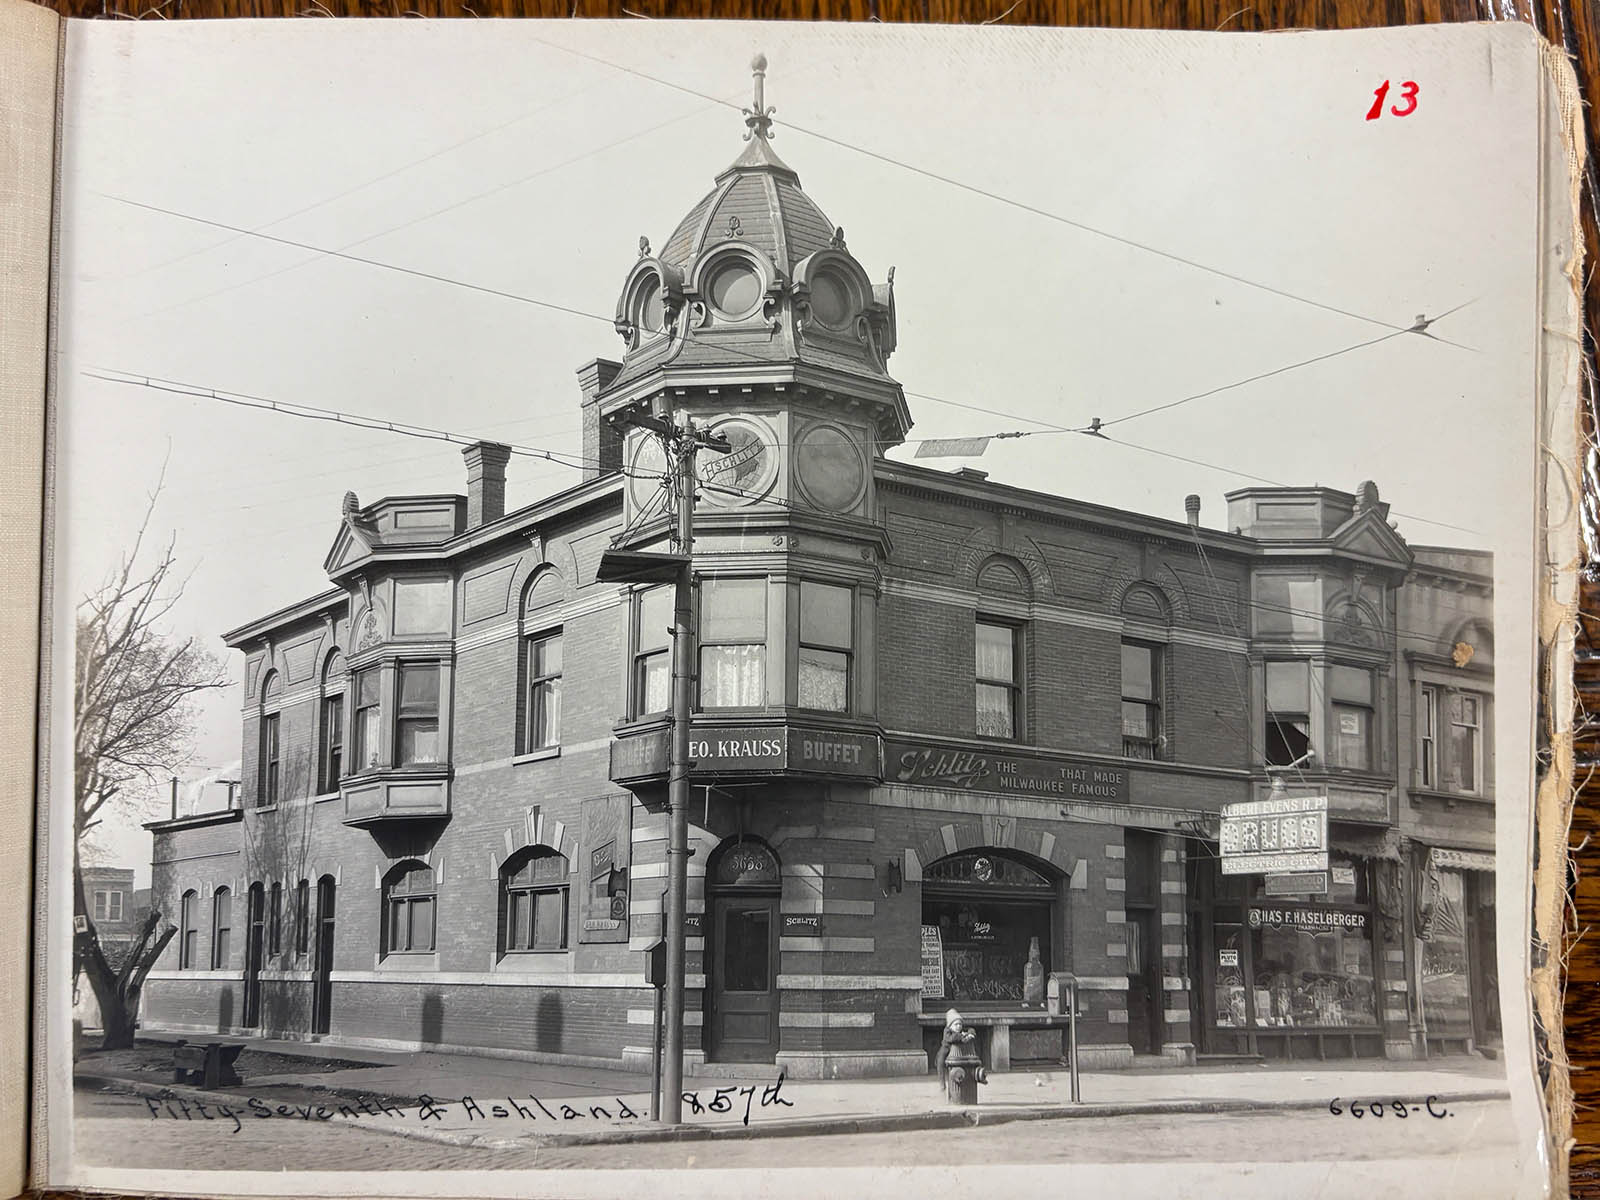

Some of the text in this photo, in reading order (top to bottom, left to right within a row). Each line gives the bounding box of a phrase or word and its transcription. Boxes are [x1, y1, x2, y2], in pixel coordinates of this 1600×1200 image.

[1365, 79, 1419, 121] 13
[687, 739, 782, 758] EO. KRAUSS
[803, 740, 862, 764] BUFFET
[897, 750, 990, 788] Schlitz
[995, 761, 1122, 785] THE THAT MADE
[1000, 777, 1117, 798] MILWAUKEE FAMOUS
[1262, 800, 1299, 814] EVENS
[1222, 817, 1319, 852] DRUGS
[1294, 911, 1365, 927] HASELBERGER
[146, 1094, 648, 1133] Fifty-Seventh & Ashland.
[1330, 1095, 1455, 1118] 6609-C.
